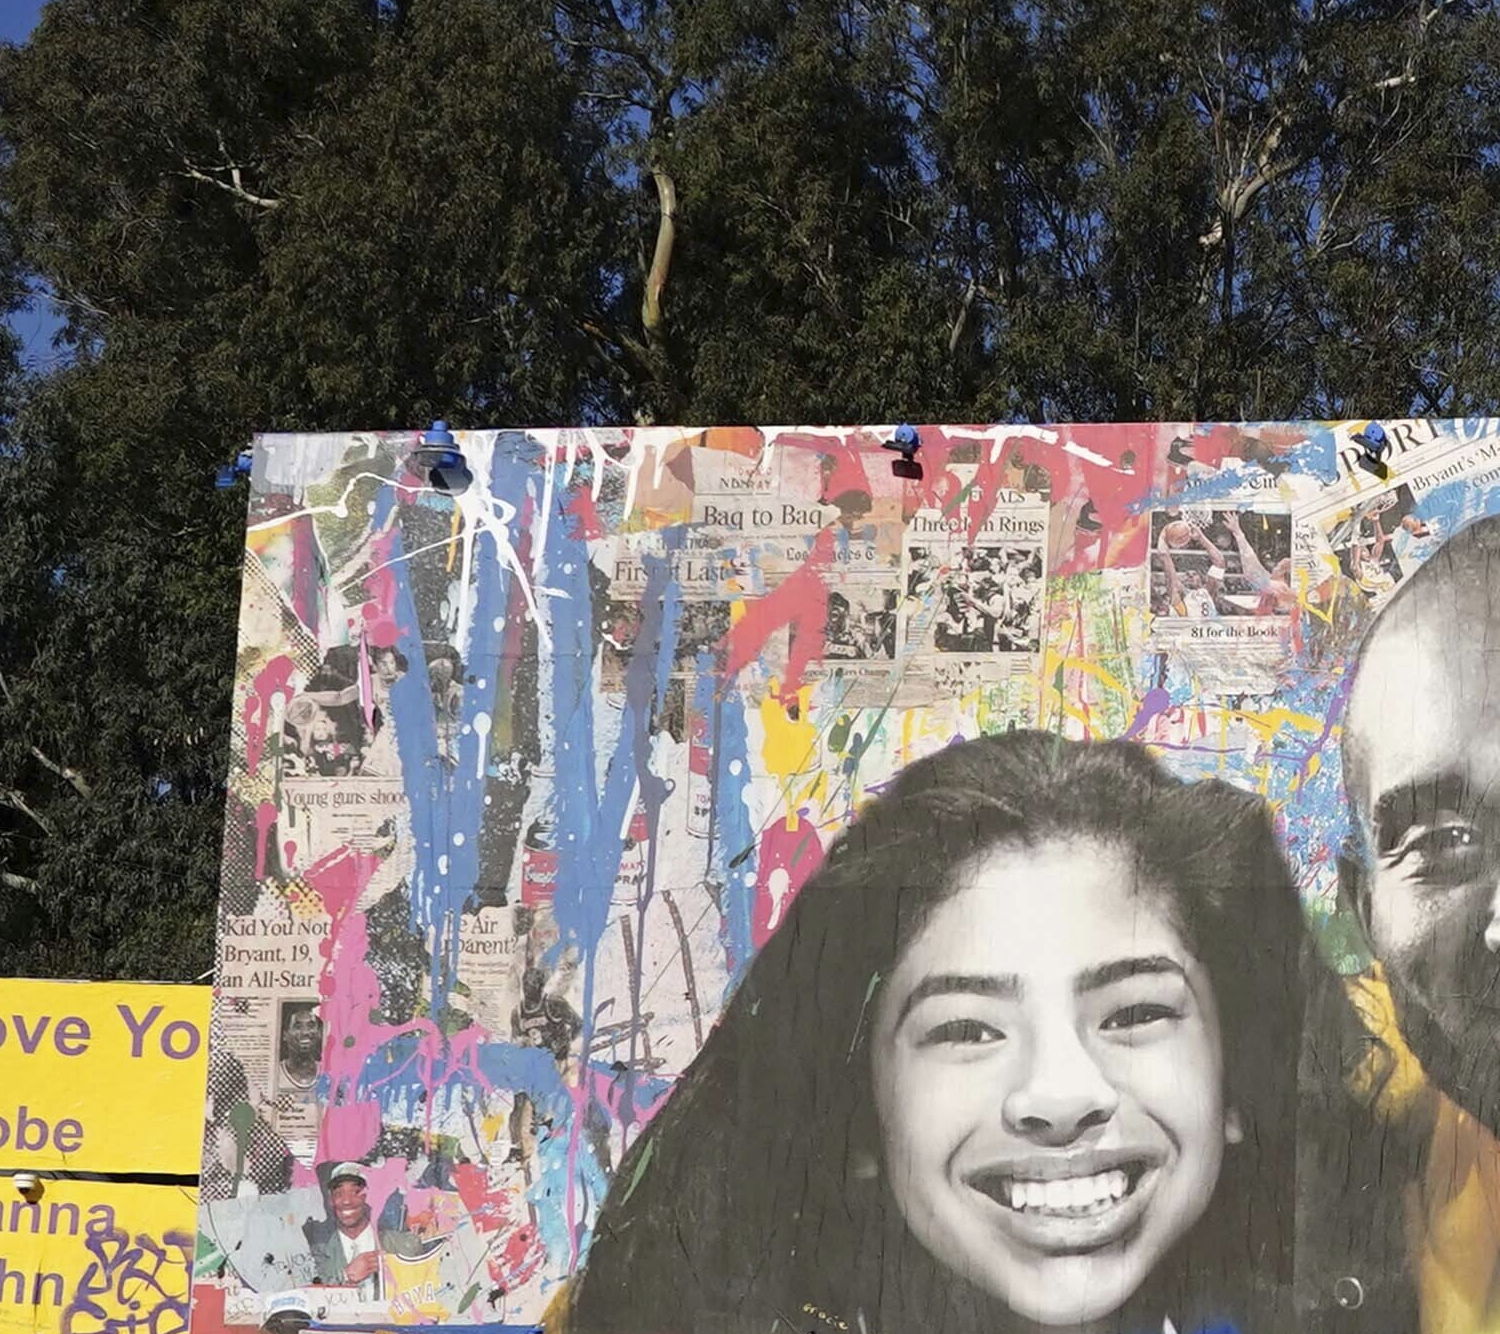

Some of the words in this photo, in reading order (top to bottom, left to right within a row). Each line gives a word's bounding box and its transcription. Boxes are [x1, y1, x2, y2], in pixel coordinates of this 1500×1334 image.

[703, 505, 743, 530] Baq
[752, 509, 773, 527] to
[781, 504, 823, 529] Baq
[998, 517, 1045, 534] Rings
[686, 561, 726, 582] Last
[1206, 627, 1225, 638] for
[1226, 626, 1246, 638] the
[284, 788, 328, 809] Young
[331, 792, 369, 809] guns
[225, 920, 256, 936] Kid
[259, 920, 297, 936] You
[299, 918, 329, 936] Not
[473, 917, 499, 935] Air
[225, 945, 287, 967] Bryant,
[291, 943, 314, 964] 19,
[222, 974, 244, 988] an
[250, 970, 315, 988] All-Star
[116, 1004, 202, 1061] Yo
